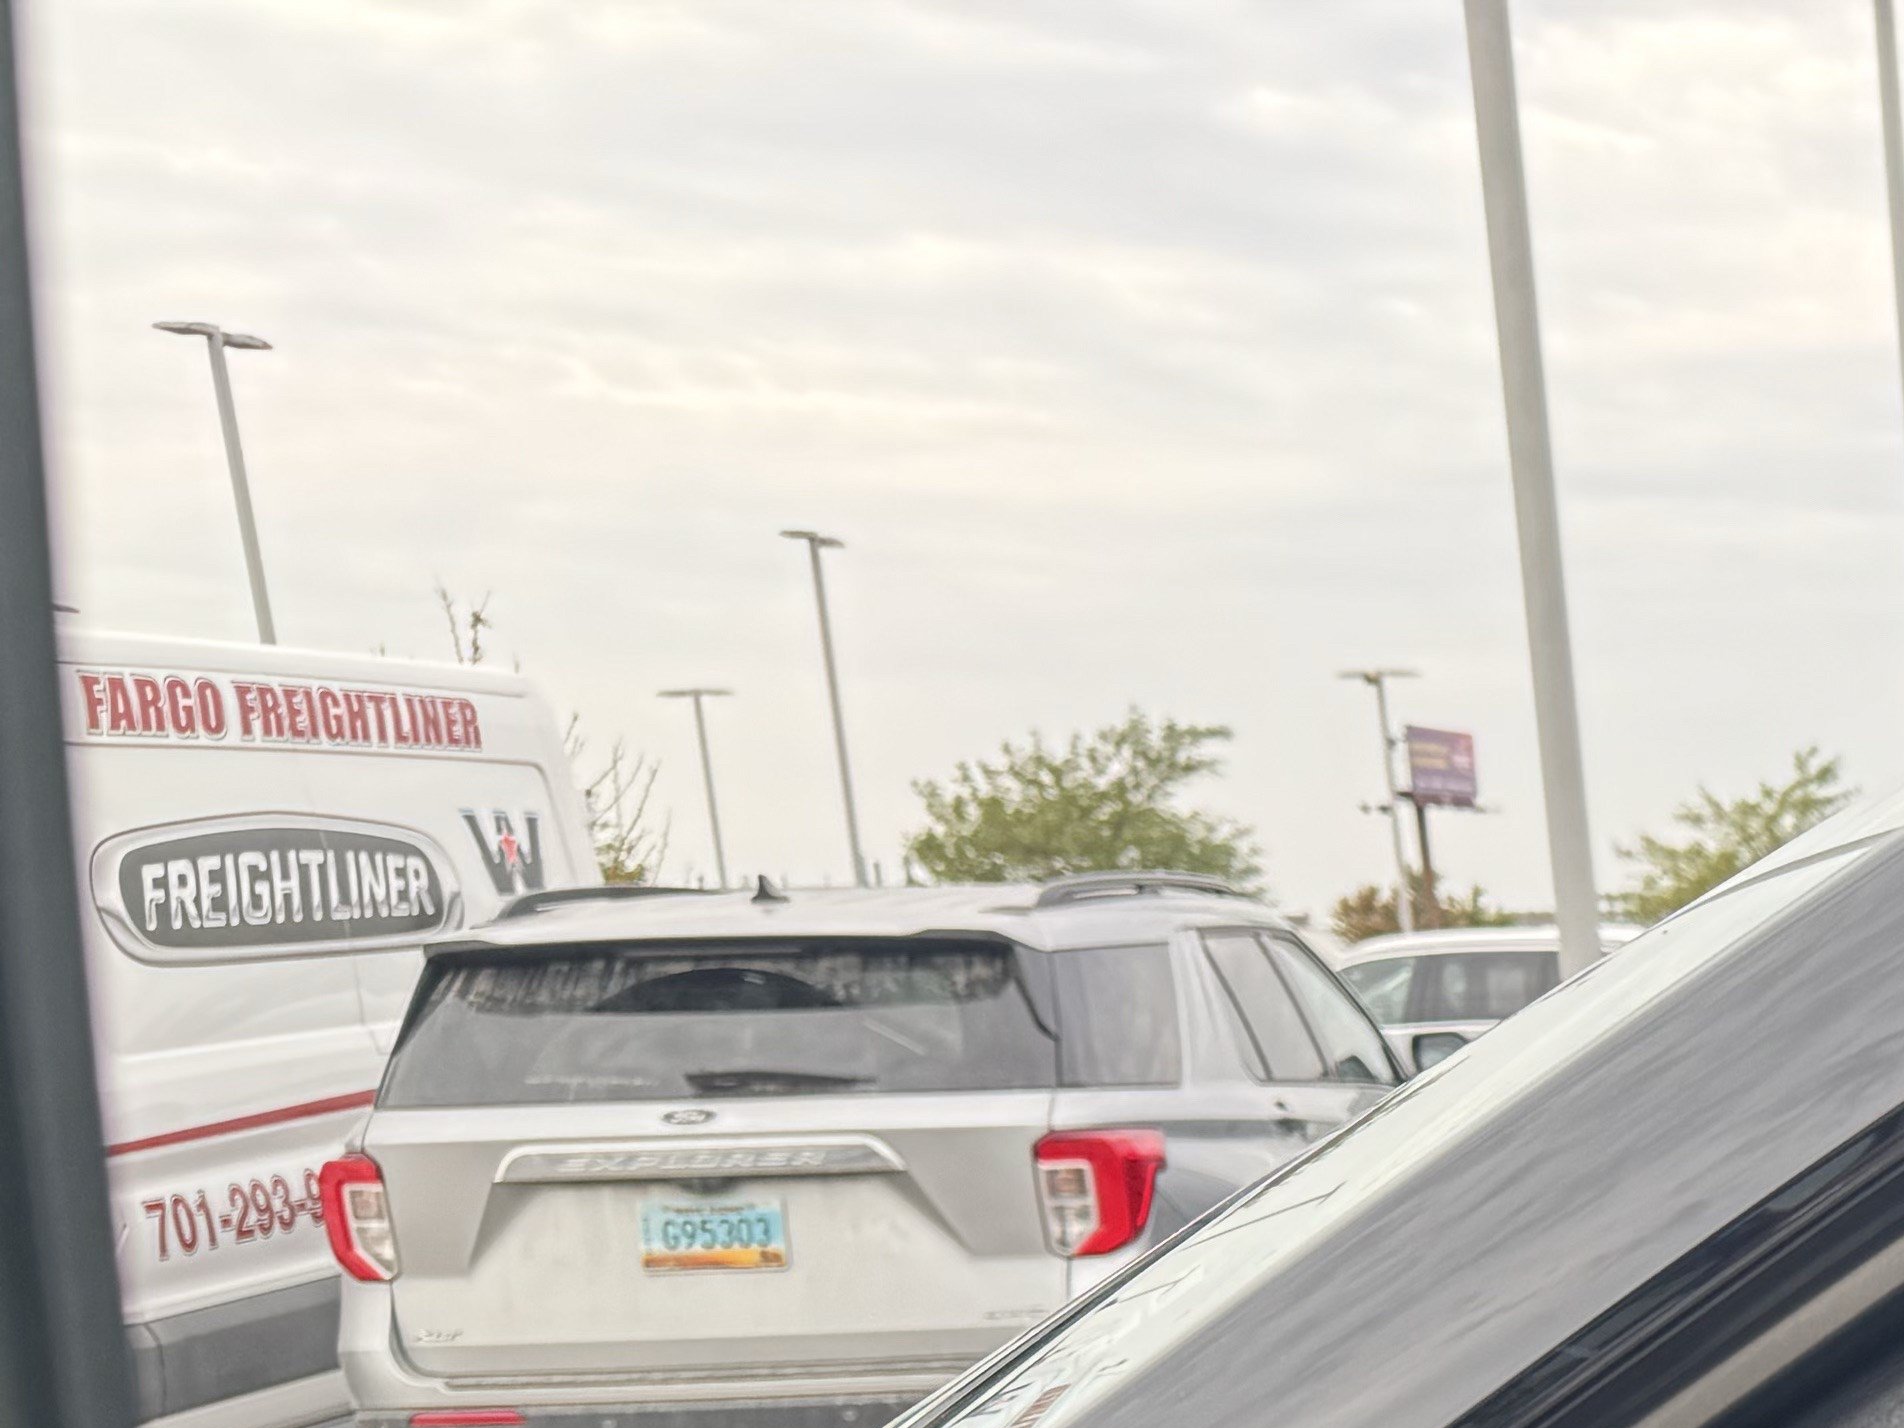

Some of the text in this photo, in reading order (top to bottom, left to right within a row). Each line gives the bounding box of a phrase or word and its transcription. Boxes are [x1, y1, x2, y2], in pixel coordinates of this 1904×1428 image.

[77, 670, 482, 752] FARGO FREIGHTLINER
[140, 849, 436, 931] FREIGHTLINER
[662, 1216, 771, 1250] G95303
